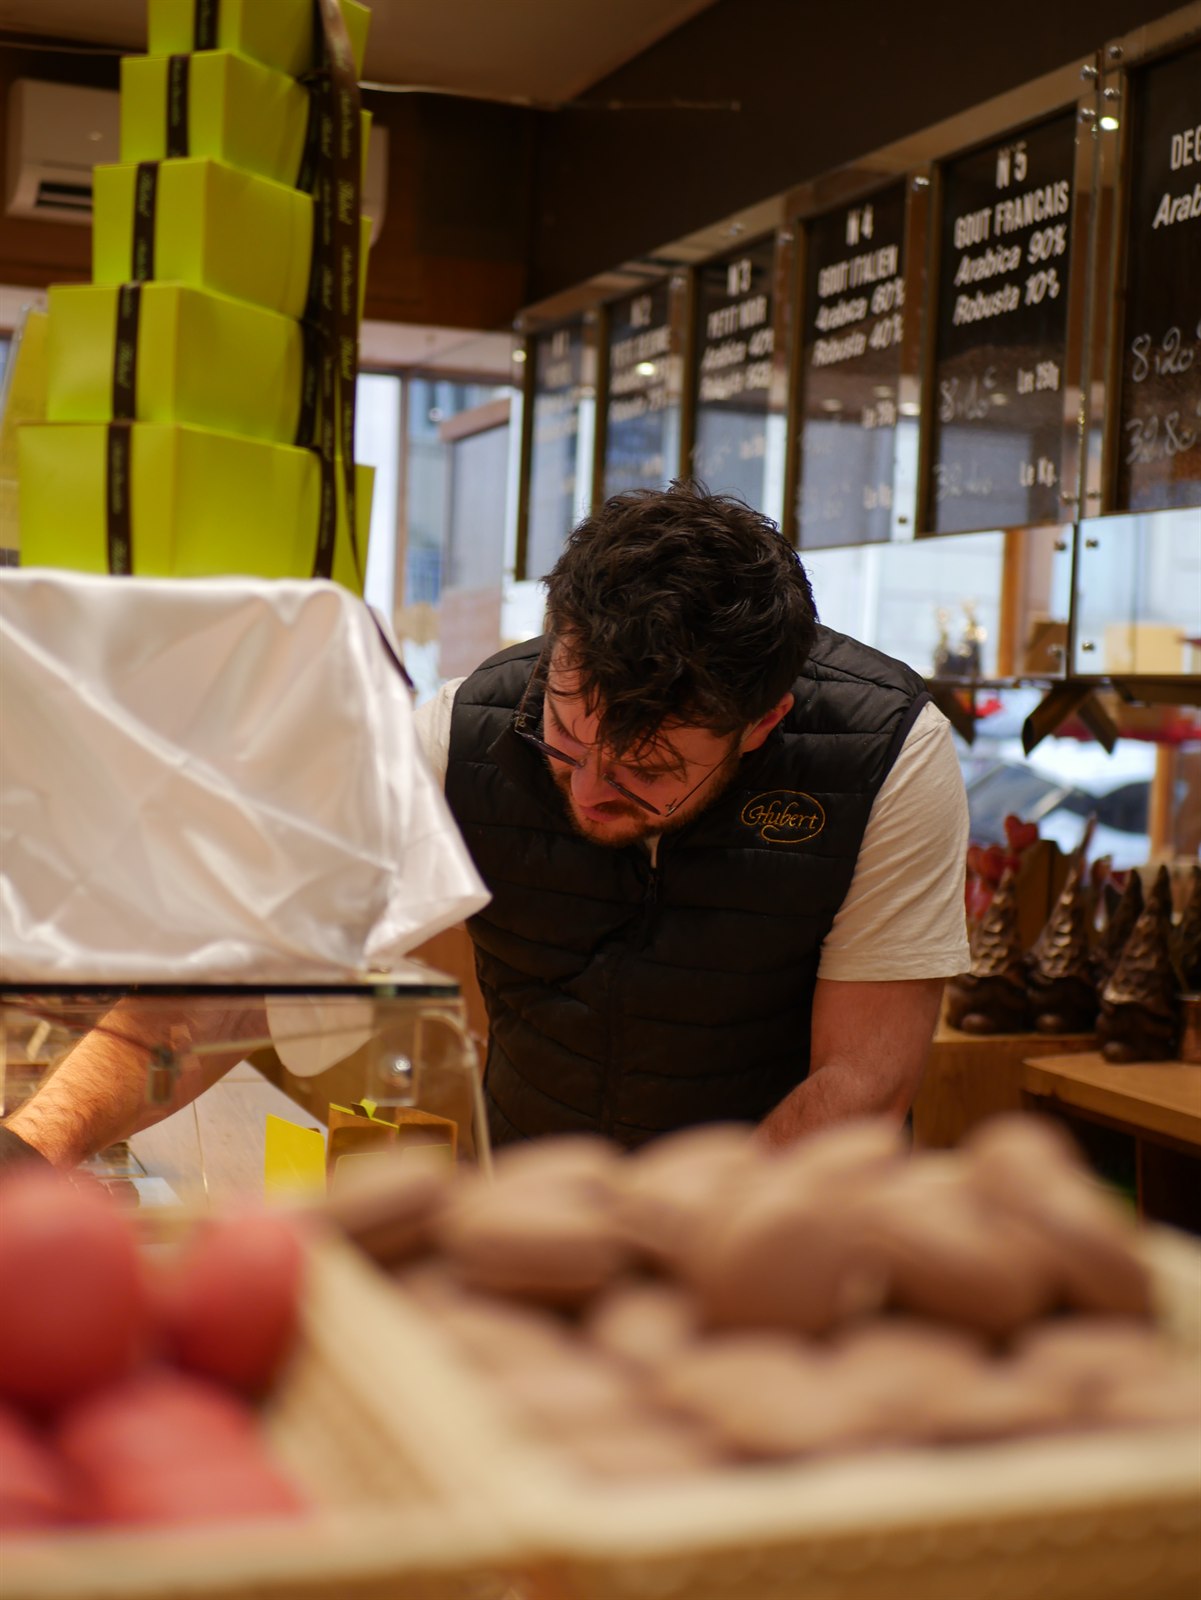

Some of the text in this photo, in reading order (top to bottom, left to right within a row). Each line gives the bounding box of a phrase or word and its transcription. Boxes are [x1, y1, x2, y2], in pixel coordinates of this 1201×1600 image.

[954, 180, 1069, 249] GOUT FRANCAIS
[954, 225, 1066, 287] Arabica 90%
[815, 297, 867, 332] Arabica
[953, 268, 1060, 326] Robusta 10%
[812, 332, 866, 367] Robusta
[744, 797, 822, 832] Hubert
